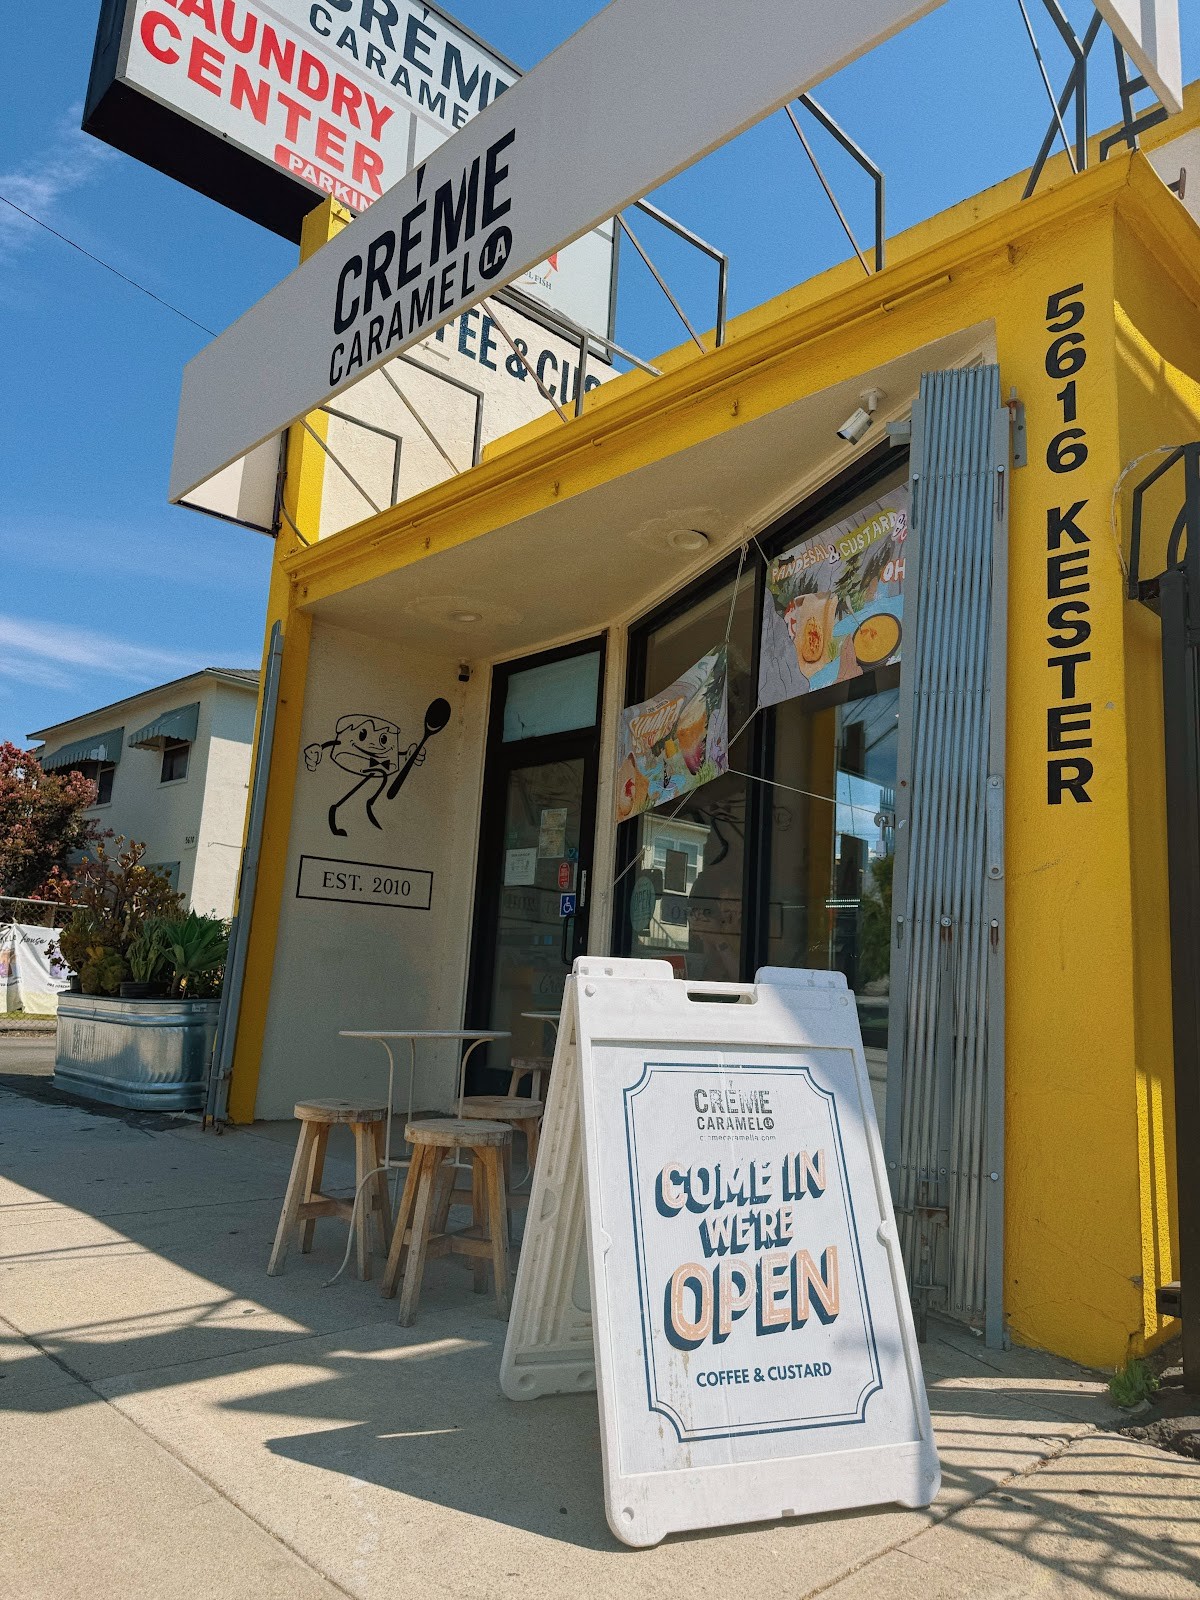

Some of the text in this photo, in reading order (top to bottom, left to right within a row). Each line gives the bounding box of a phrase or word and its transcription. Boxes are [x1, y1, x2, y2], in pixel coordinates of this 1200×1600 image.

[140, 10, 385, 196] CENTER
[163, 0, 395, 143] AUNDRY
[505, 337, 529, 383] &
[771, 543, 831, 585] PANDESAL
[1044, 282, 1094, 806] 5616 KESTER
[322, 871, 411, 897] EST. 2010
[655, 1149, 827, 1218] COME IN
[663, 1245, 840, 1352] OPEN
[696, 1361, 832, 1388] COFFEE & CUSTARD
